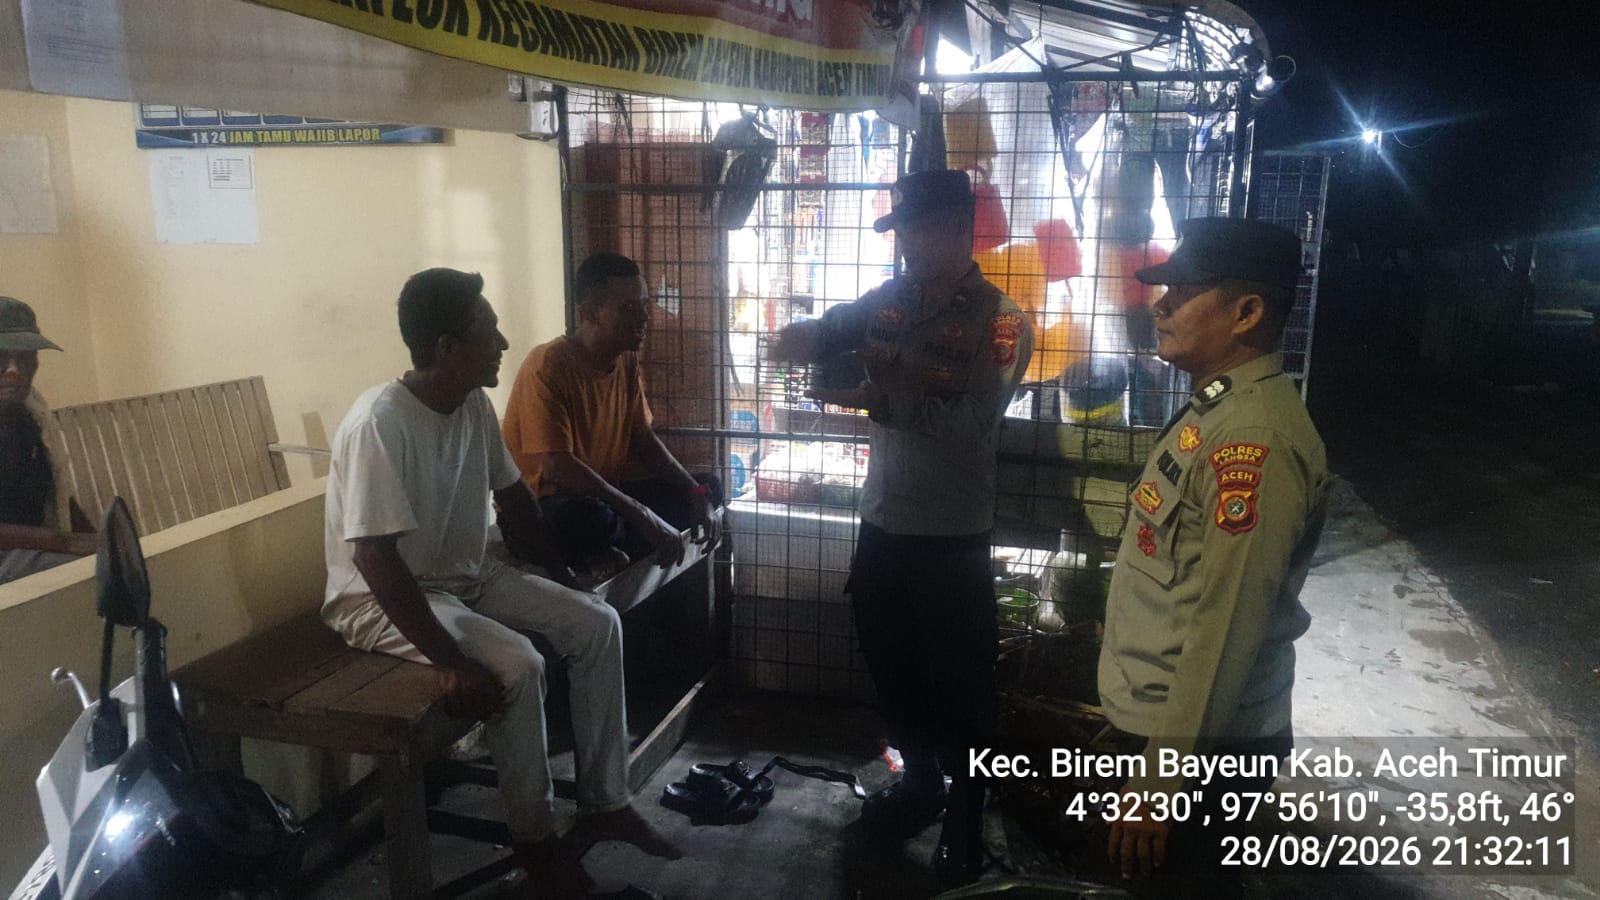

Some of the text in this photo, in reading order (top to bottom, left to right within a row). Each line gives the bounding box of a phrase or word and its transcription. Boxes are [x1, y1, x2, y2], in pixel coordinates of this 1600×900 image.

[476, 0, 641, 72] KECAMATAN
[633, 26, 704, 81] BIREM
[754, 47, 814, 97] KABUPATEN
[817, 60, 852, 97] ACEH
[192, 132, 198, 144] 1
[211, 131, 227, 144] 24
[230, 131, 254, 143] JAM
[256, 130, 291, 143] TAMU
[294, 129, 336, 142] WAJIB
[338, 128, 381, 142] LAPOR
[1213, 446, 1263, 462] POLRES
[1222, 472, 1254, 482] ACEH
